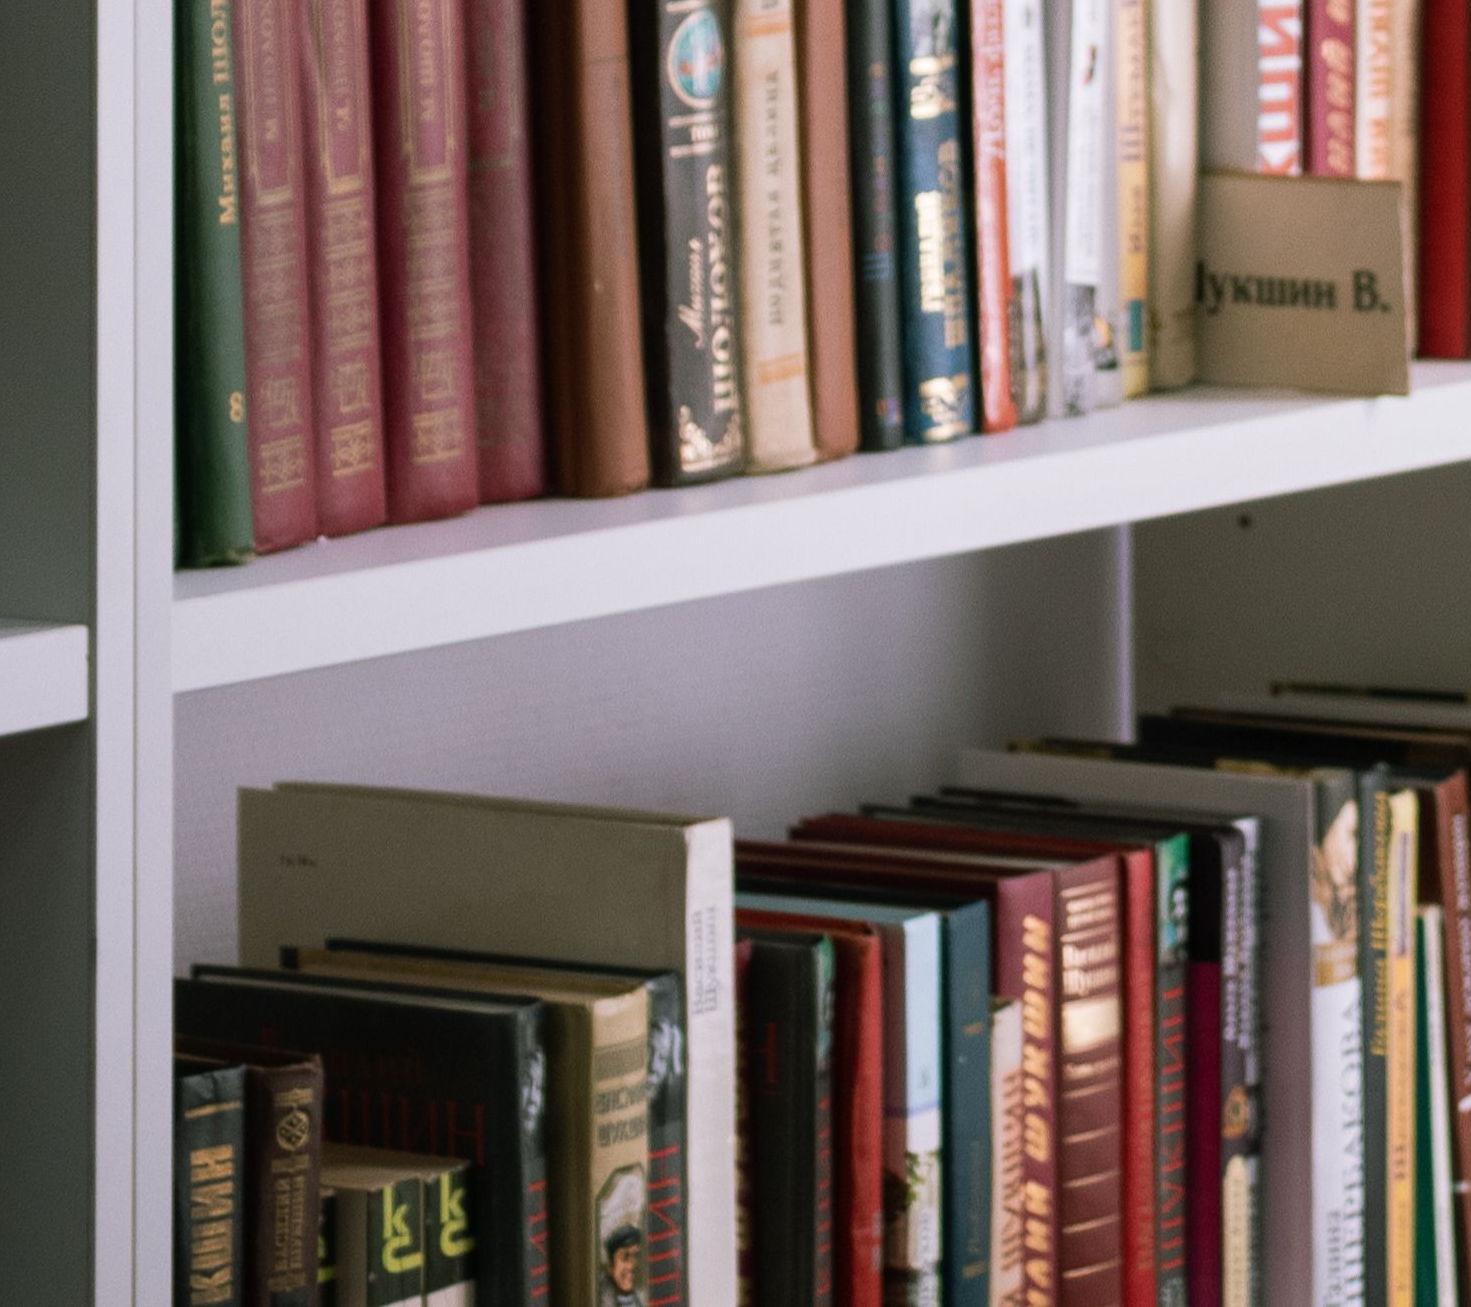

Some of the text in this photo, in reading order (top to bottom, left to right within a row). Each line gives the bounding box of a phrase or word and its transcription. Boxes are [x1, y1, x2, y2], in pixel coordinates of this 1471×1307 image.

[218, 90, 240, 227] Михаил
[1351, 268, 1392, 313] В.
[229, 391, 245, 423] 8
